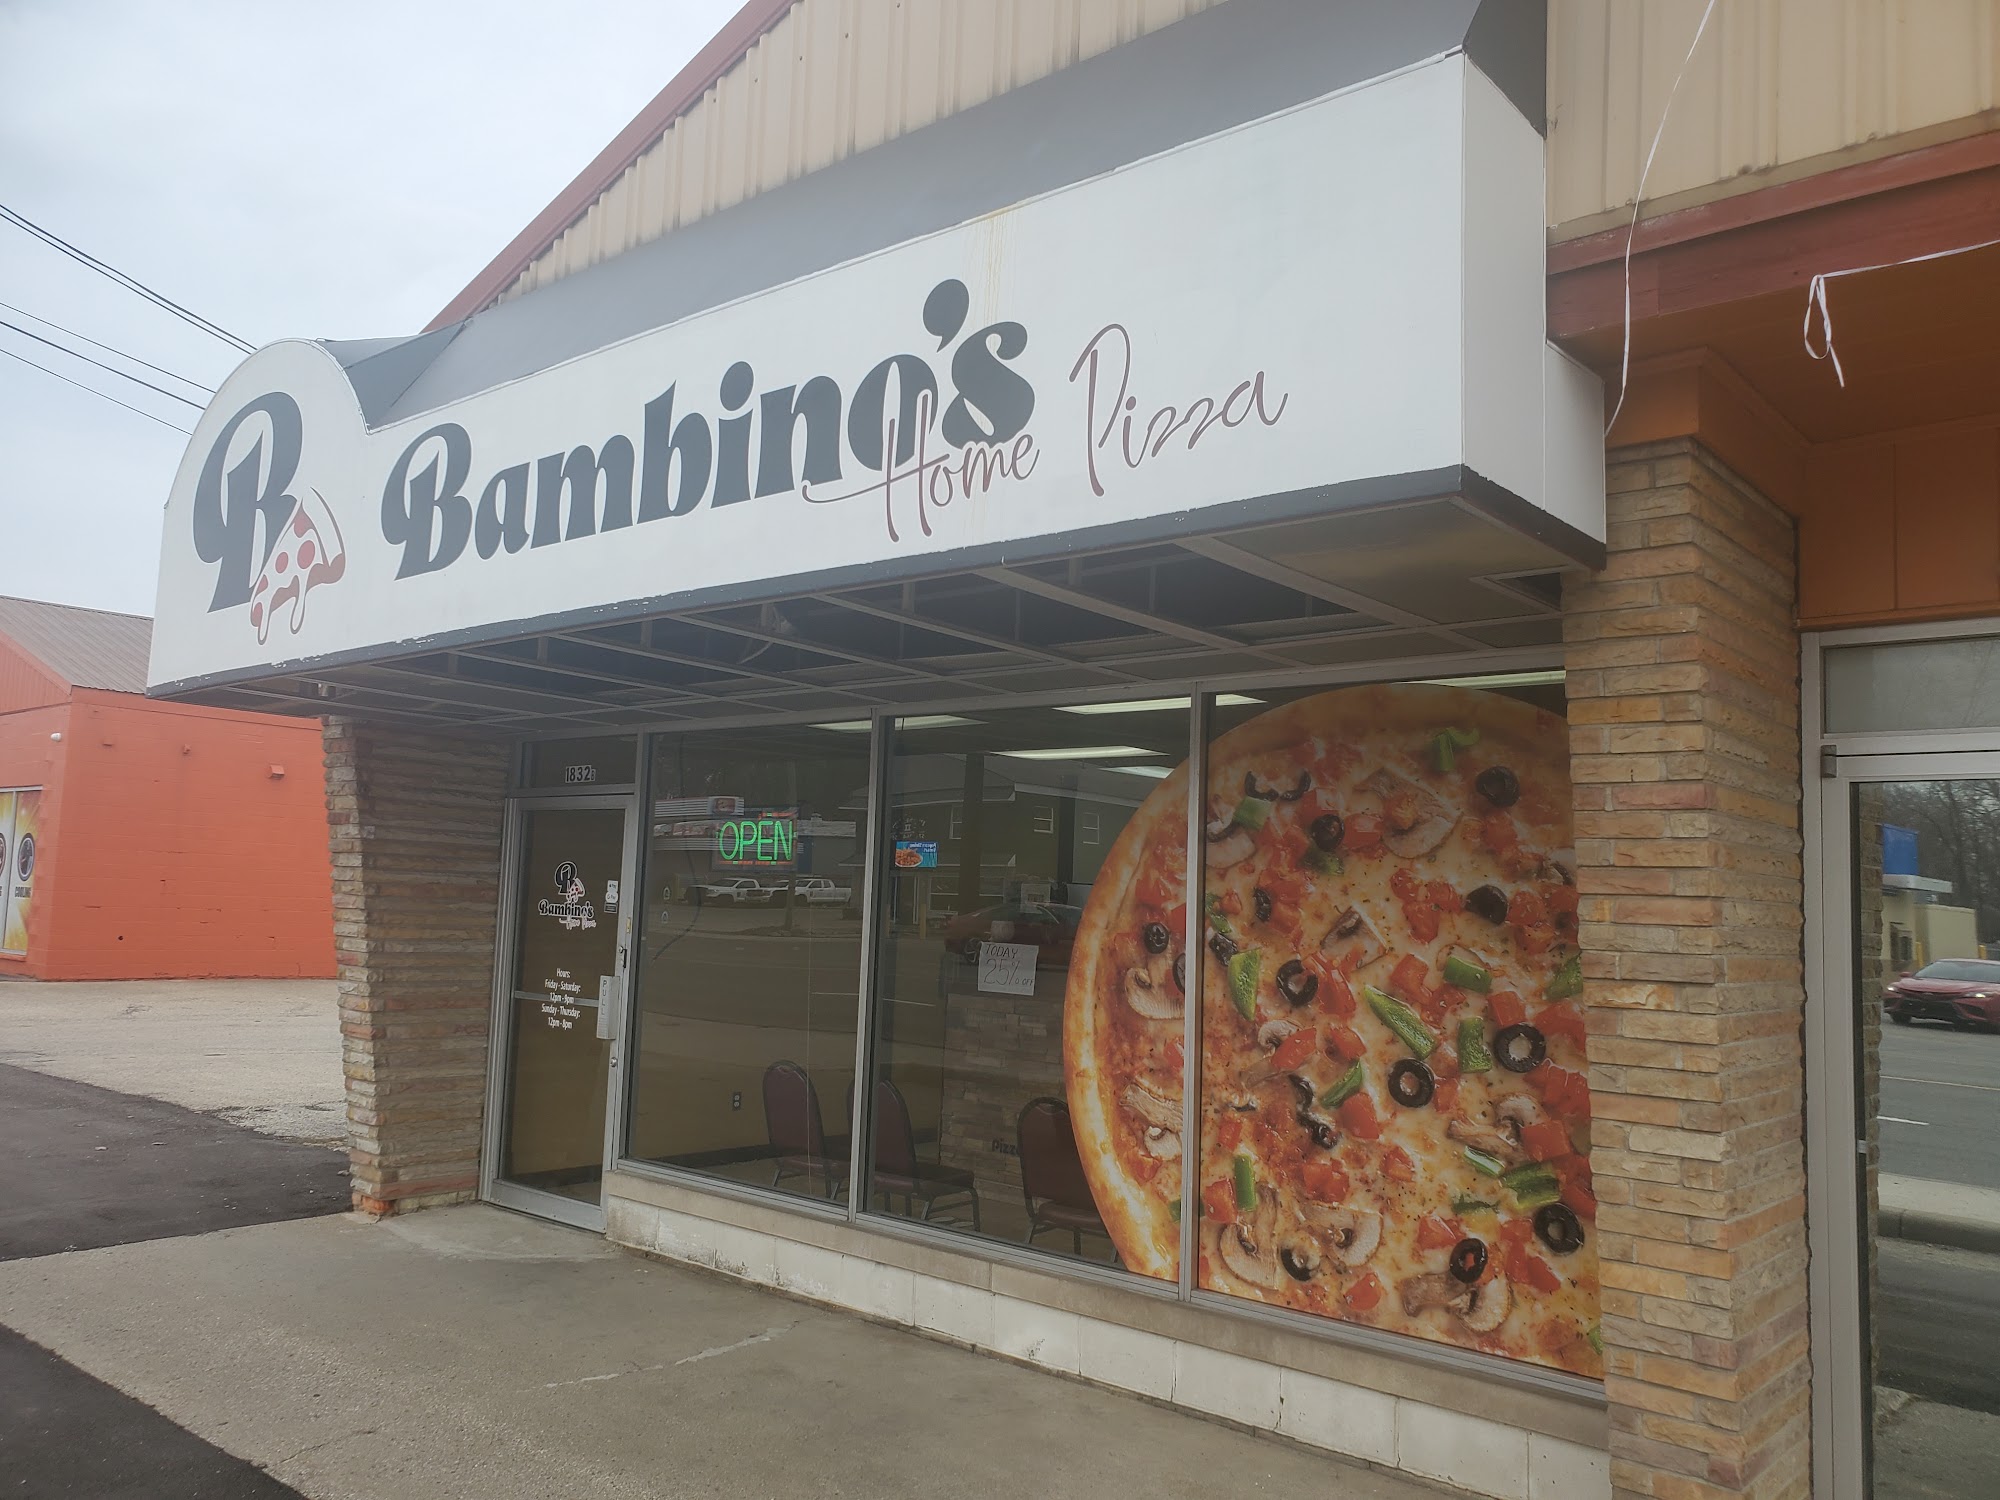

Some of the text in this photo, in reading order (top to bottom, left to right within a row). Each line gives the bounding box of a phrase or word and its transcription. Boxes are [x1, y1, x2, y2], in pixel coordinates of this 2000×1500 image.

[380, 279, 1036, 581] Bambino's
[802, 323, 1290, 543] Home Pizza
[192, 390, 304, 614] B
[719, 820, 793, 861] OPEN
[538, 899, 594, 919] Bambino's
[985, 943, 1019, 959] TODAY
[556, 967, 571, 978] Hours:
[984, 958, 1020, 986] 25%
[544, 979, 559, 991] Friday
[560, 980, 581, 994] Saturday:
[549, 991, 562, 1004] 12pm
[541, 1003, 558, 1016] Sunday
[560, 1005, 581, 1019] Thursday:
[547, 1016, 560, 1028] 12pm
